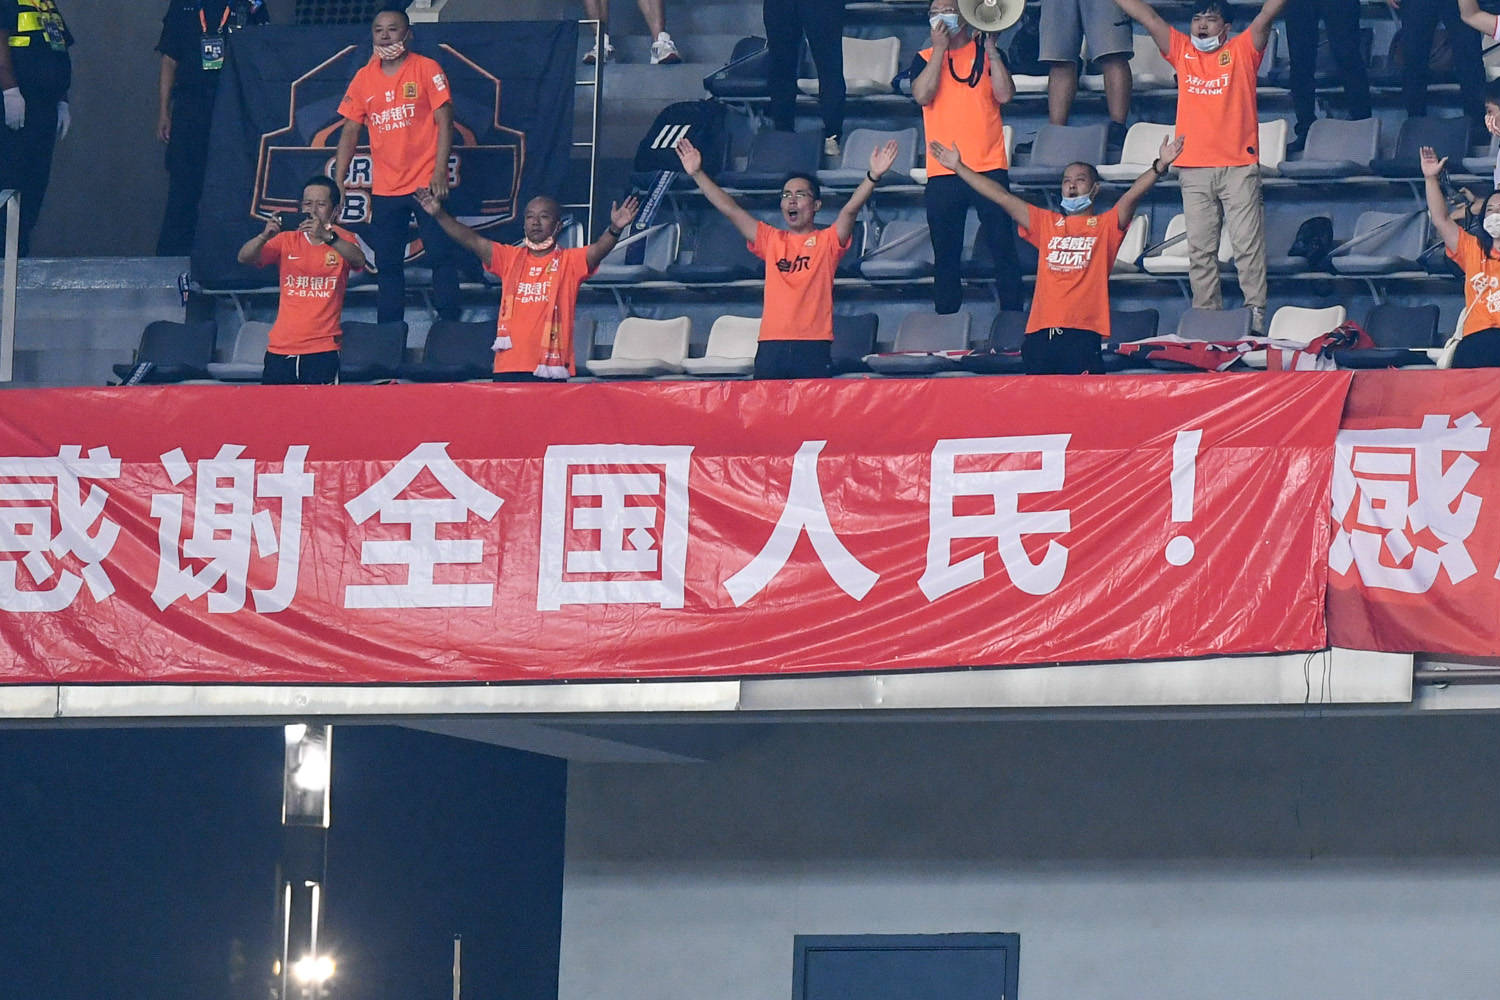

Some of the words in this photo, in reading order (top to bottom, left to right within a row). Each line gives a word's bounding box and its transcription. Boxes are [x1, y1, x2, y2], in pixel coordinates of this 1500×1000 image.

[285, 273, 338, 291] 众邦银行
[287, 289, 331, 299] Z-BANK
